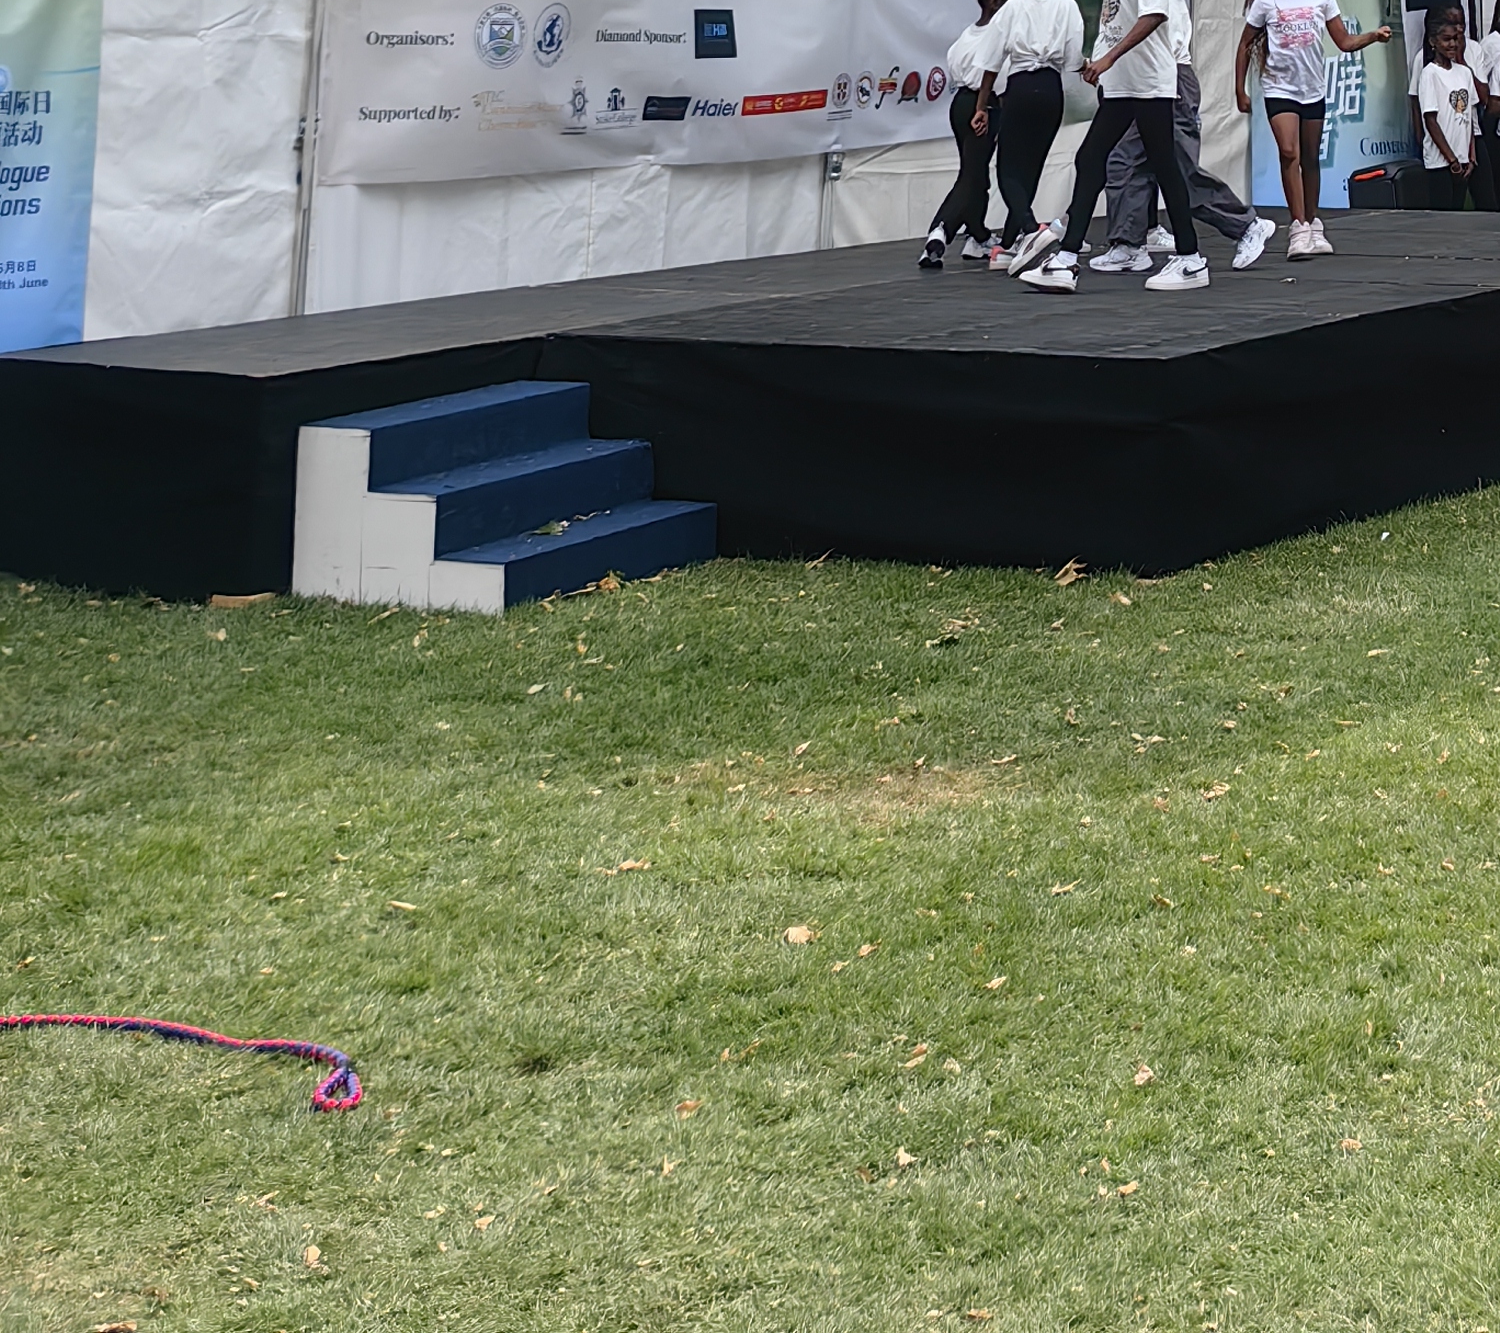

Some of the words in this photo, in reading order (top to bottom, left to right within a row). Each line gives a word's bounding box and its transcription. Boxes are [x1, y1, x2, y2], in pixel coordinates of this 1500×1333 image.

[366, 31, 455, 48] Organisors:
[596, 29, 641, 43] Diamond
[358, 106, 436, 124] Supported
[692, 99, 738, 117] Haier
[0, 120, 43, 147] 活动
[0, 161, 50, 191] ogue
[0, 196, 41, 217] ons
[19, 277, 49, 289] June
